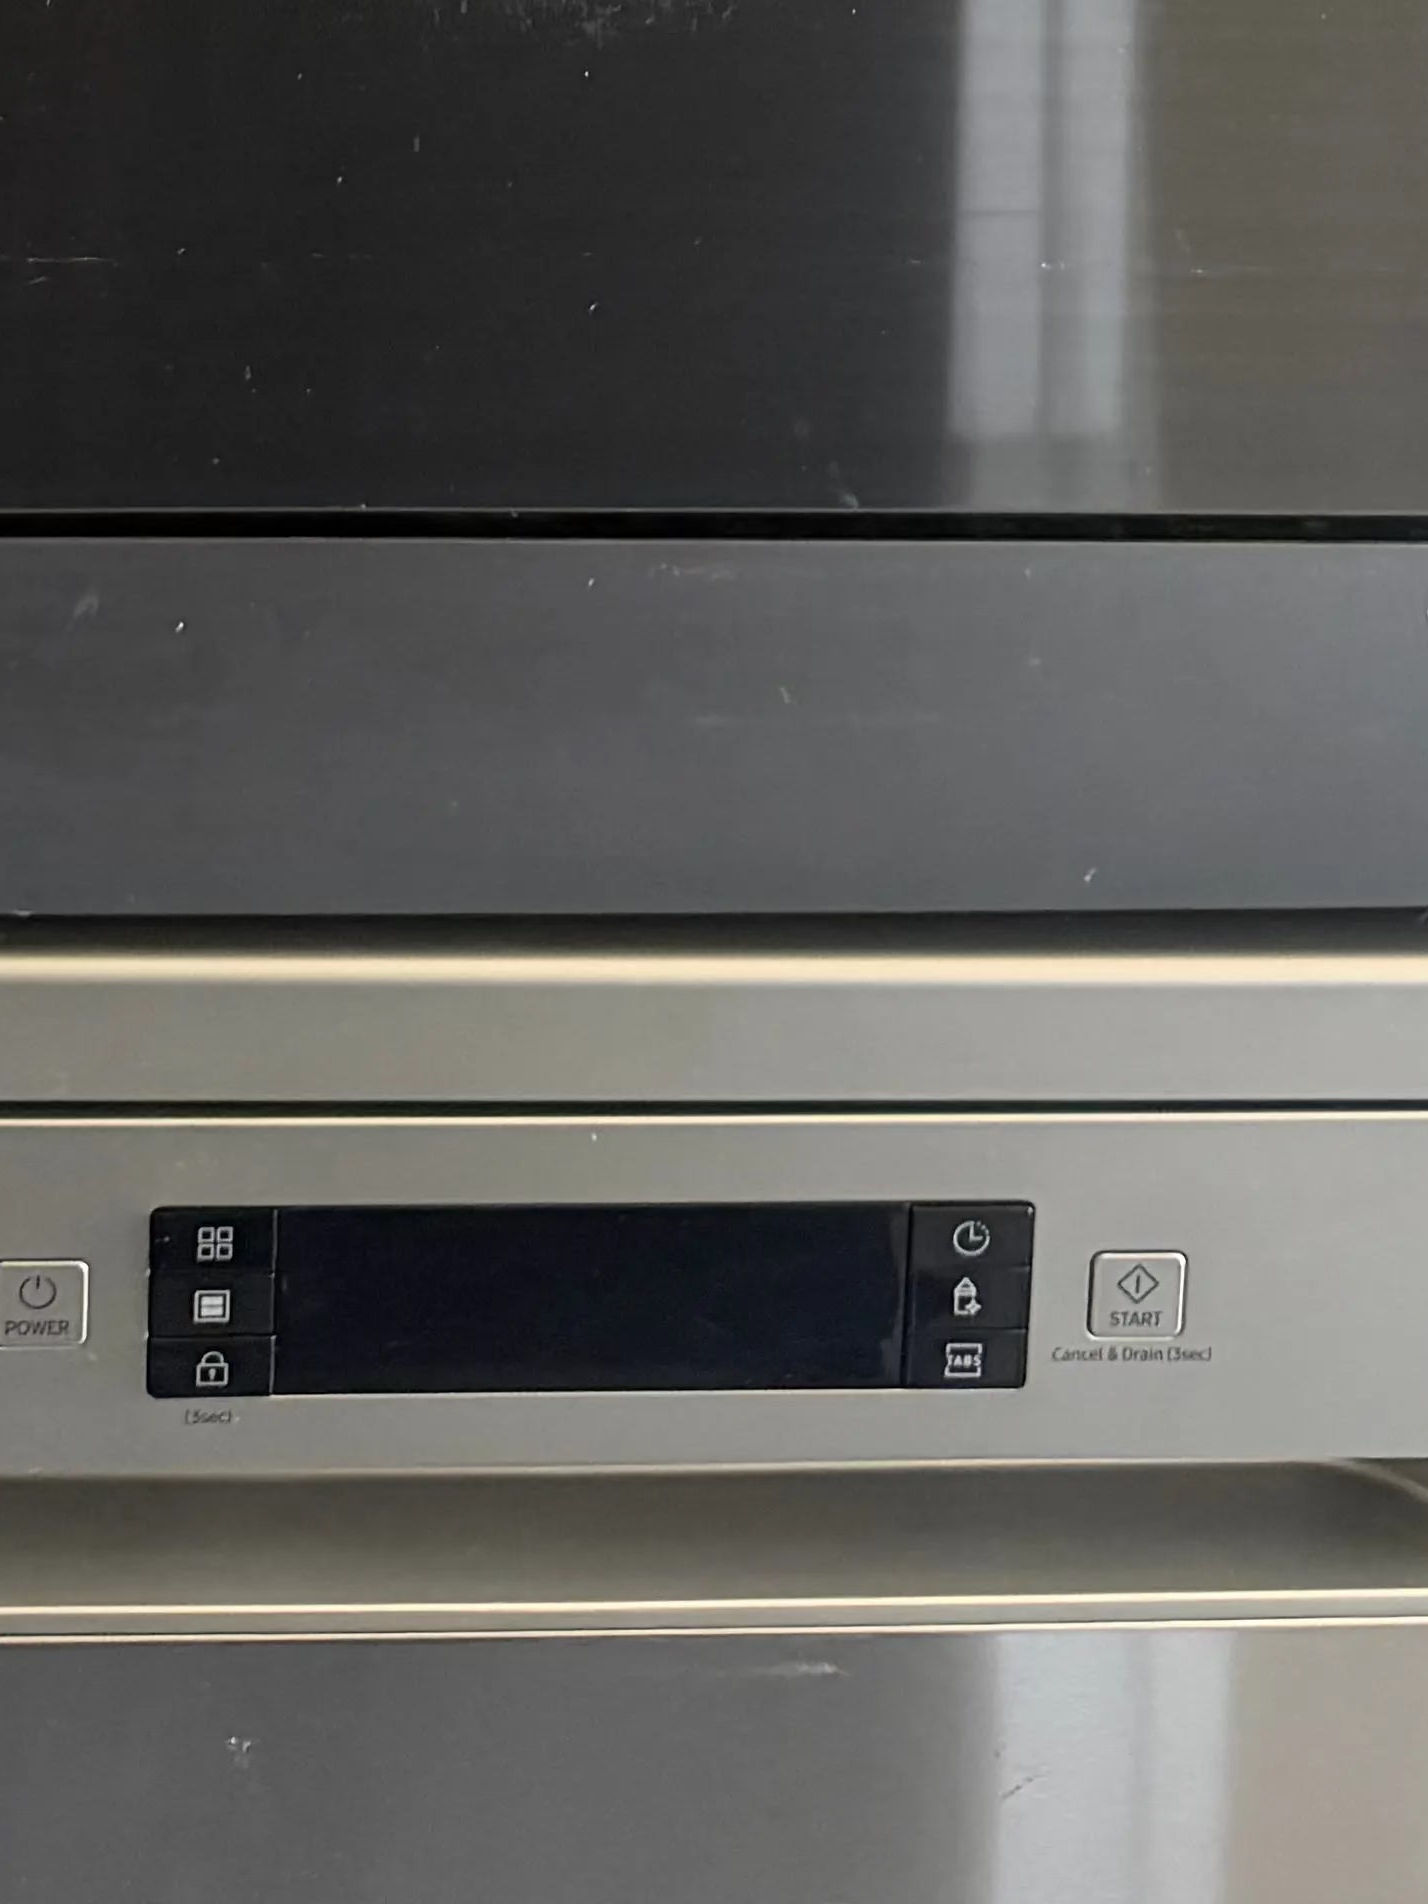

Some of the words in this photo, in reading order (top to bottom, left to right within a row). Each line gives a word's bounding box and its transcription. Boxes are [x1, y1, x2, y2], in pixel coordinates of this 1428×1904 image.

[1109, 1310, 1163, 1327] START
[4, 1319, 70, 1336] POWER
[946, 1353, 982, 1368] TABS
[1051, 1346, 1104, 1362] Cancel
[1107, 1346, 1119, 1362] &
[1122, 1346, 1164, 1362] Drain
[1167, 1345, 1212, 1362] (3sec)
